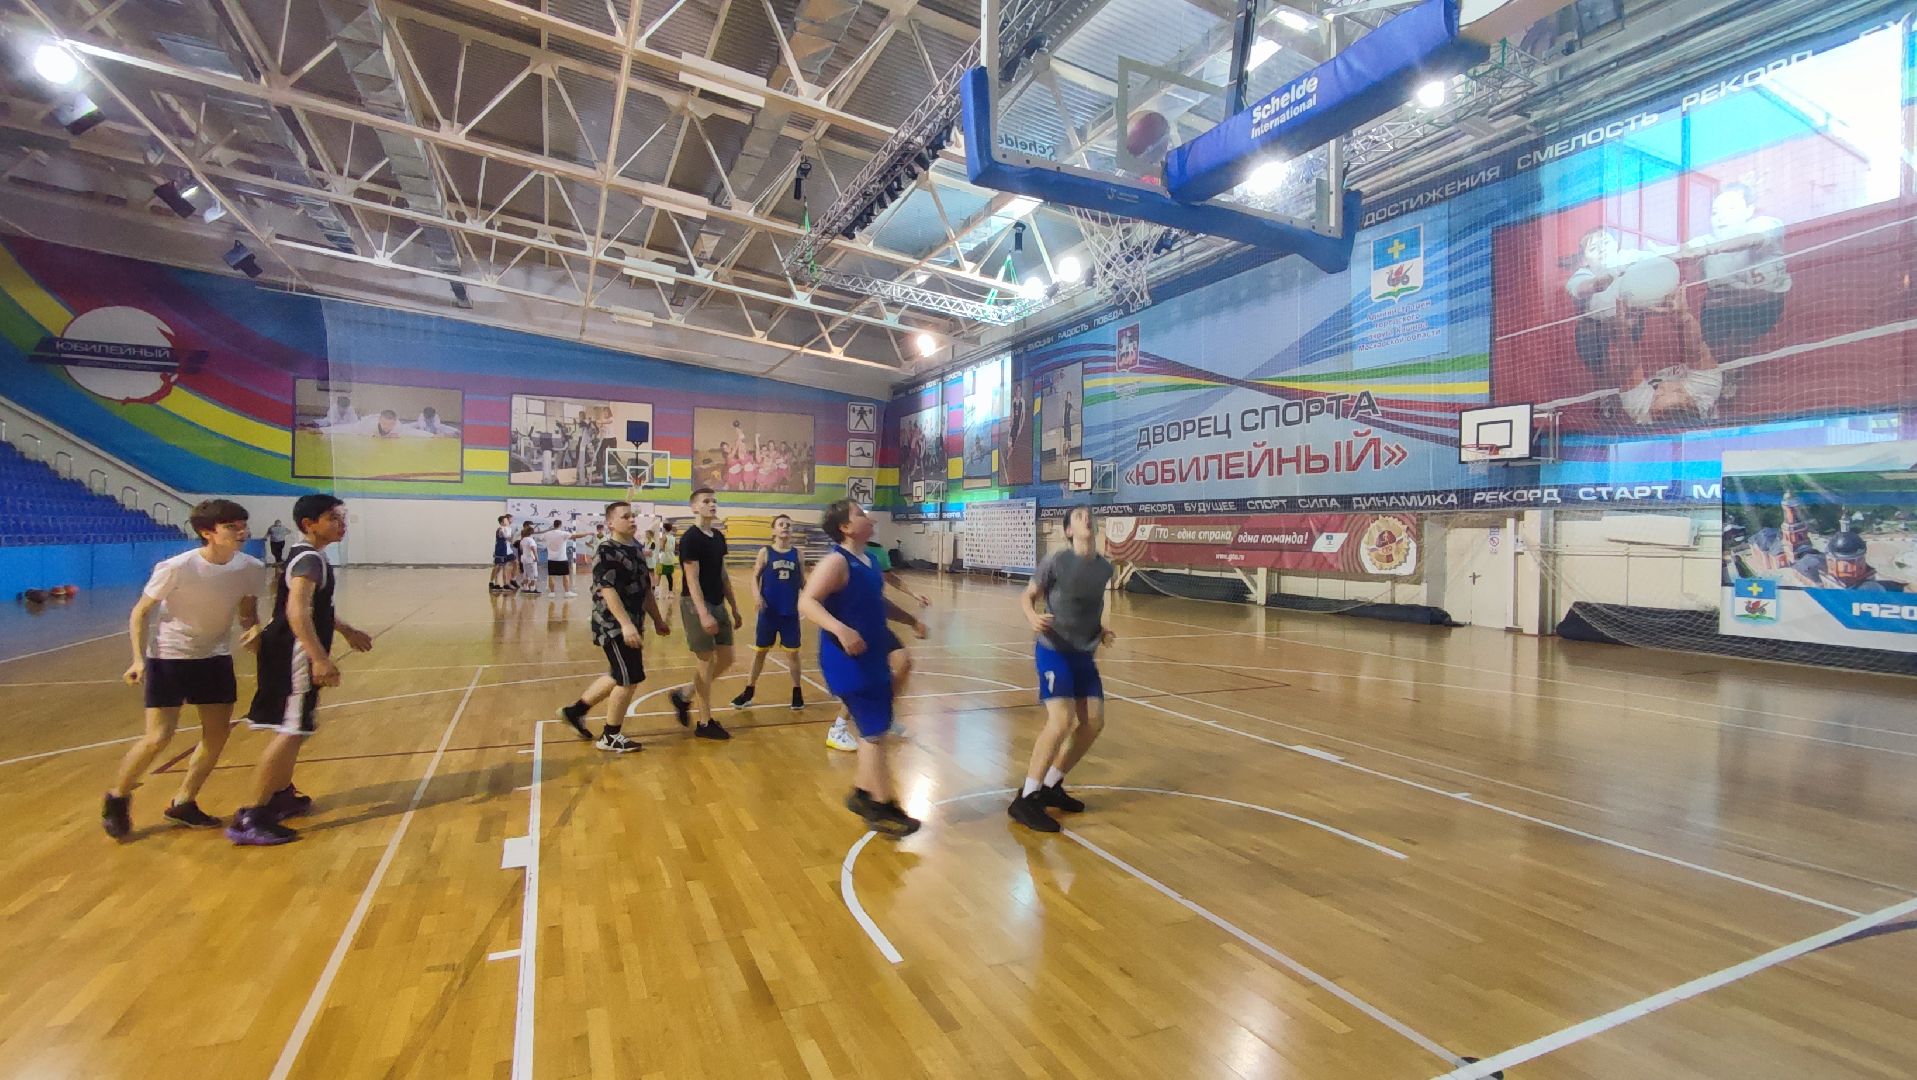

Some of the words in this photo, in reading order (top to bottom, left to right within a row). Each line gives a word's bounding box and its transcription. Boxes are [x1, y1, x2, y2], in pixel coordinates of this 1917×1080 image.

[1250, 93, 1317, 139] International
[1252, 76, 1318, 125] Schelde
[1057, 324, 1089, 339] РАДОСТЬ
[1093, 309, 1124, 326] ПОБЕДА
[1363, 166, 1500, 227] ДОСТИЖЕНИЯ
[1516, 111, 1659, 170] СМЕЛОСТЬ
[55, 340, 171, 359] ЮБИЛЕЙНЫЙ
[1136, 412, 1232, 452] ДВОРЕЦ
[1240, 390, 1381, 433] СПОРТА
[1124, 427, 1409, 487] «ЮБИЛЕЙНЫЙ»
[1091, 504, 1133, 515] СМЕЛОСТЬ
[1138, 503, 1176, 514] РЕКОРД
[1183, 501, 1237, 513] БУДУЩЕЕ
[1246, 499, 1288, 510] СПОРТ
[1297, 498, 1341, 509] СИЛА
[1352, 493, 1459, 510] ДИНАМИКА
[1473, 488, 1562, 504] РЕКОРД
[1578, 485, 1669, 501] СТАРТ
[1238, 530, 1260, 544] одна
[1261, 531, 1309, 546] команда!
